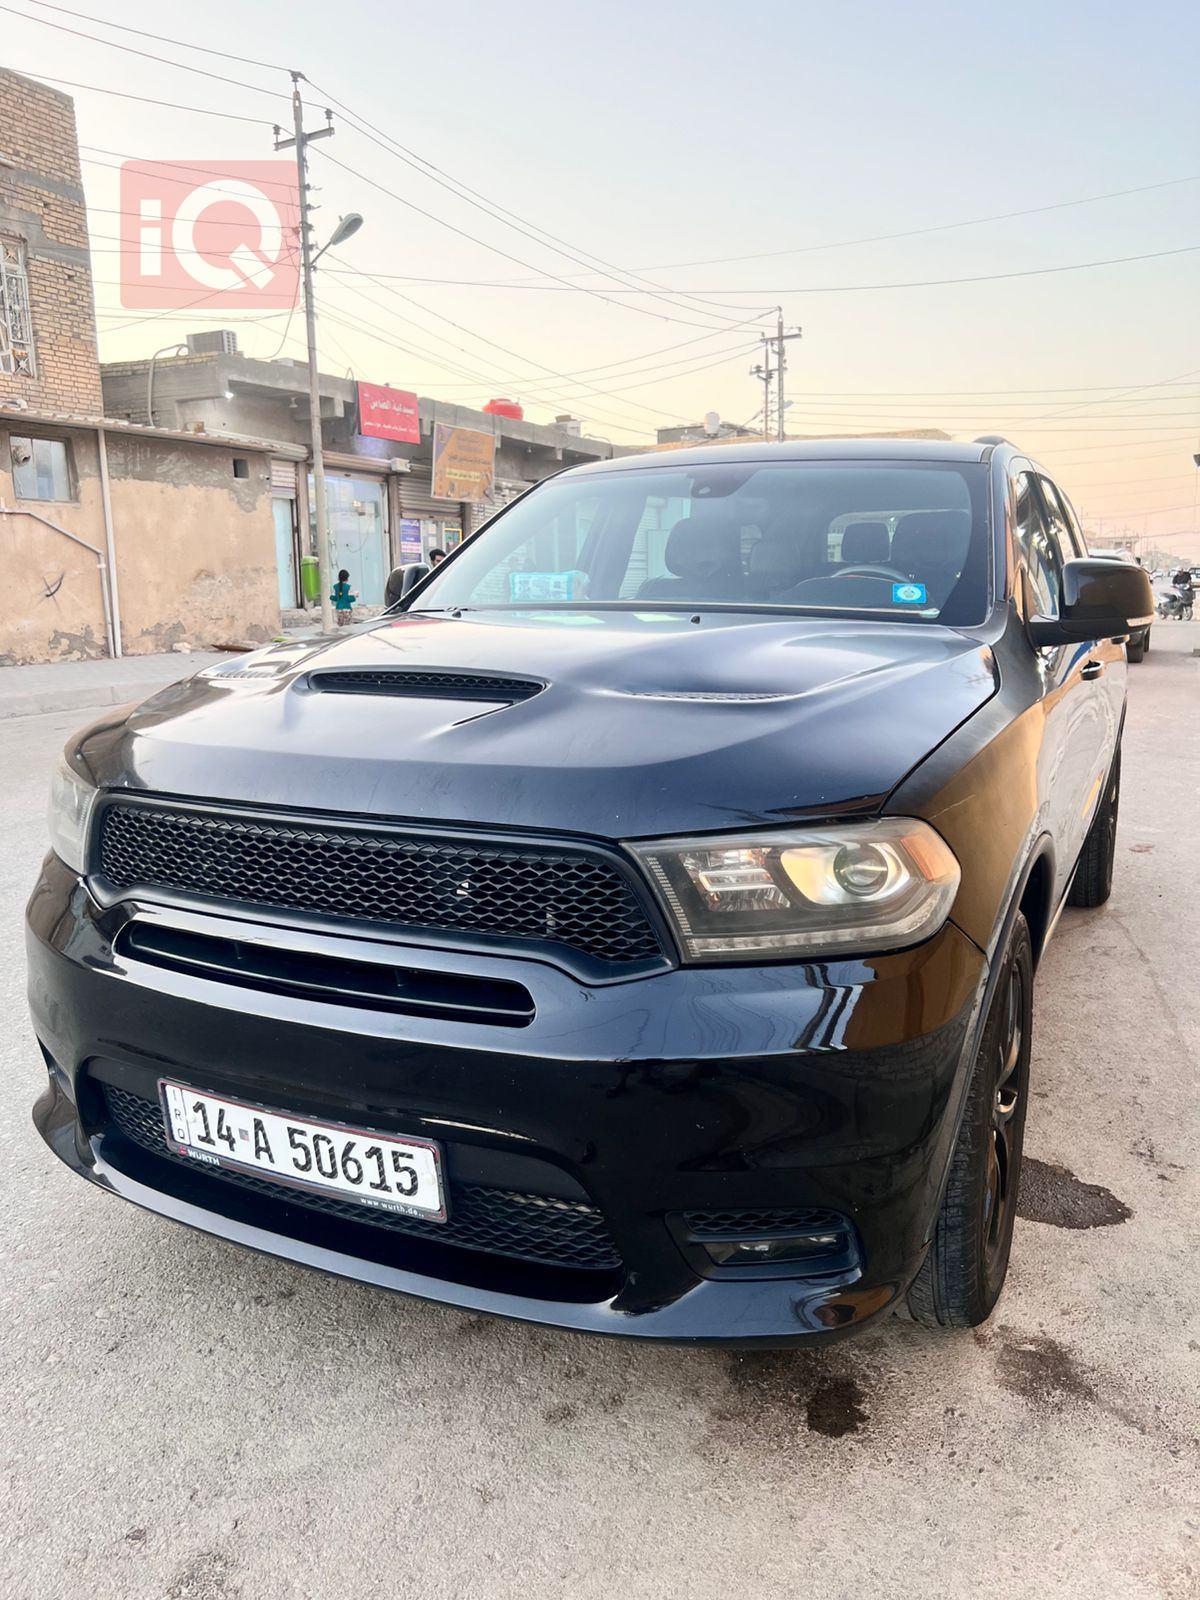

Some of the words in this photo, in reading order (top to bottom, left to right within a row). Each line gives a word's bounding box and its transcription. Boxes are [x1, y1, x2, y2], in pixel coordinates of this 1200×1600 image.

[192, 1101, 236, 1152] 14
[253, 1117, 276, 1164] A
[287, 1126, 418, 1197] 50615
